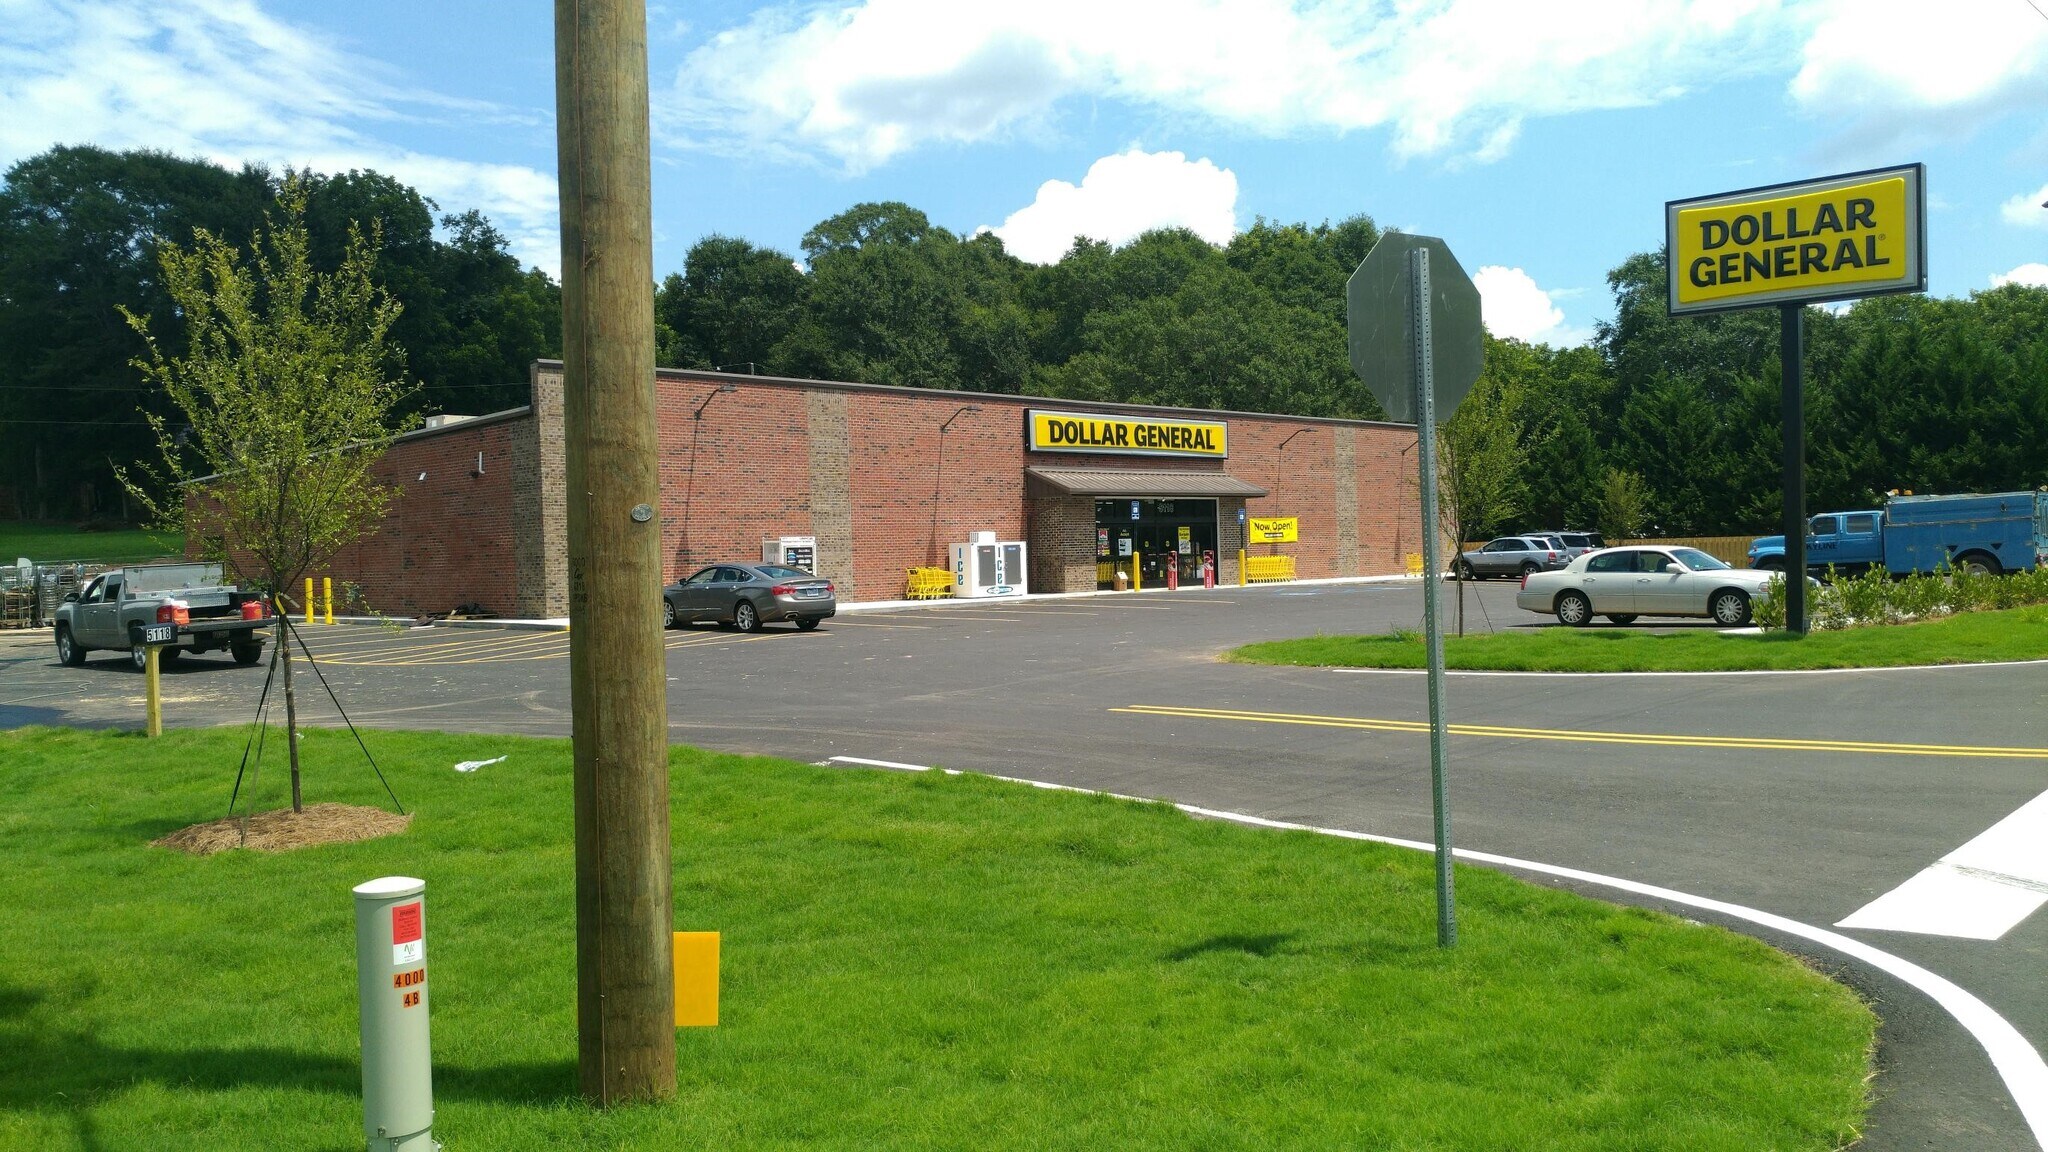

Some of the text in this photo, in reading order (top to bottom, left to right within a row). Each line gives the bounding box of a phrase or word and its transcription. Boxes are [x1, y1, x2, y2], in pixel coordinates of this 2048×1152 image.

[1699, 198, 1877, 250] DOLLAR
[1689, 235, 1890, 288] GENERAL
[1048, 420, 1216, 450] DOLLAR GENERAL
[1254, 521, 1293, 531] Now Open!
[1805, 542, 1838, 551] KYLINE
[147, 627, 170, 641] 5118
[395, 968, 425, 988] 4000
[404, 991, 419, 1007] 4B
